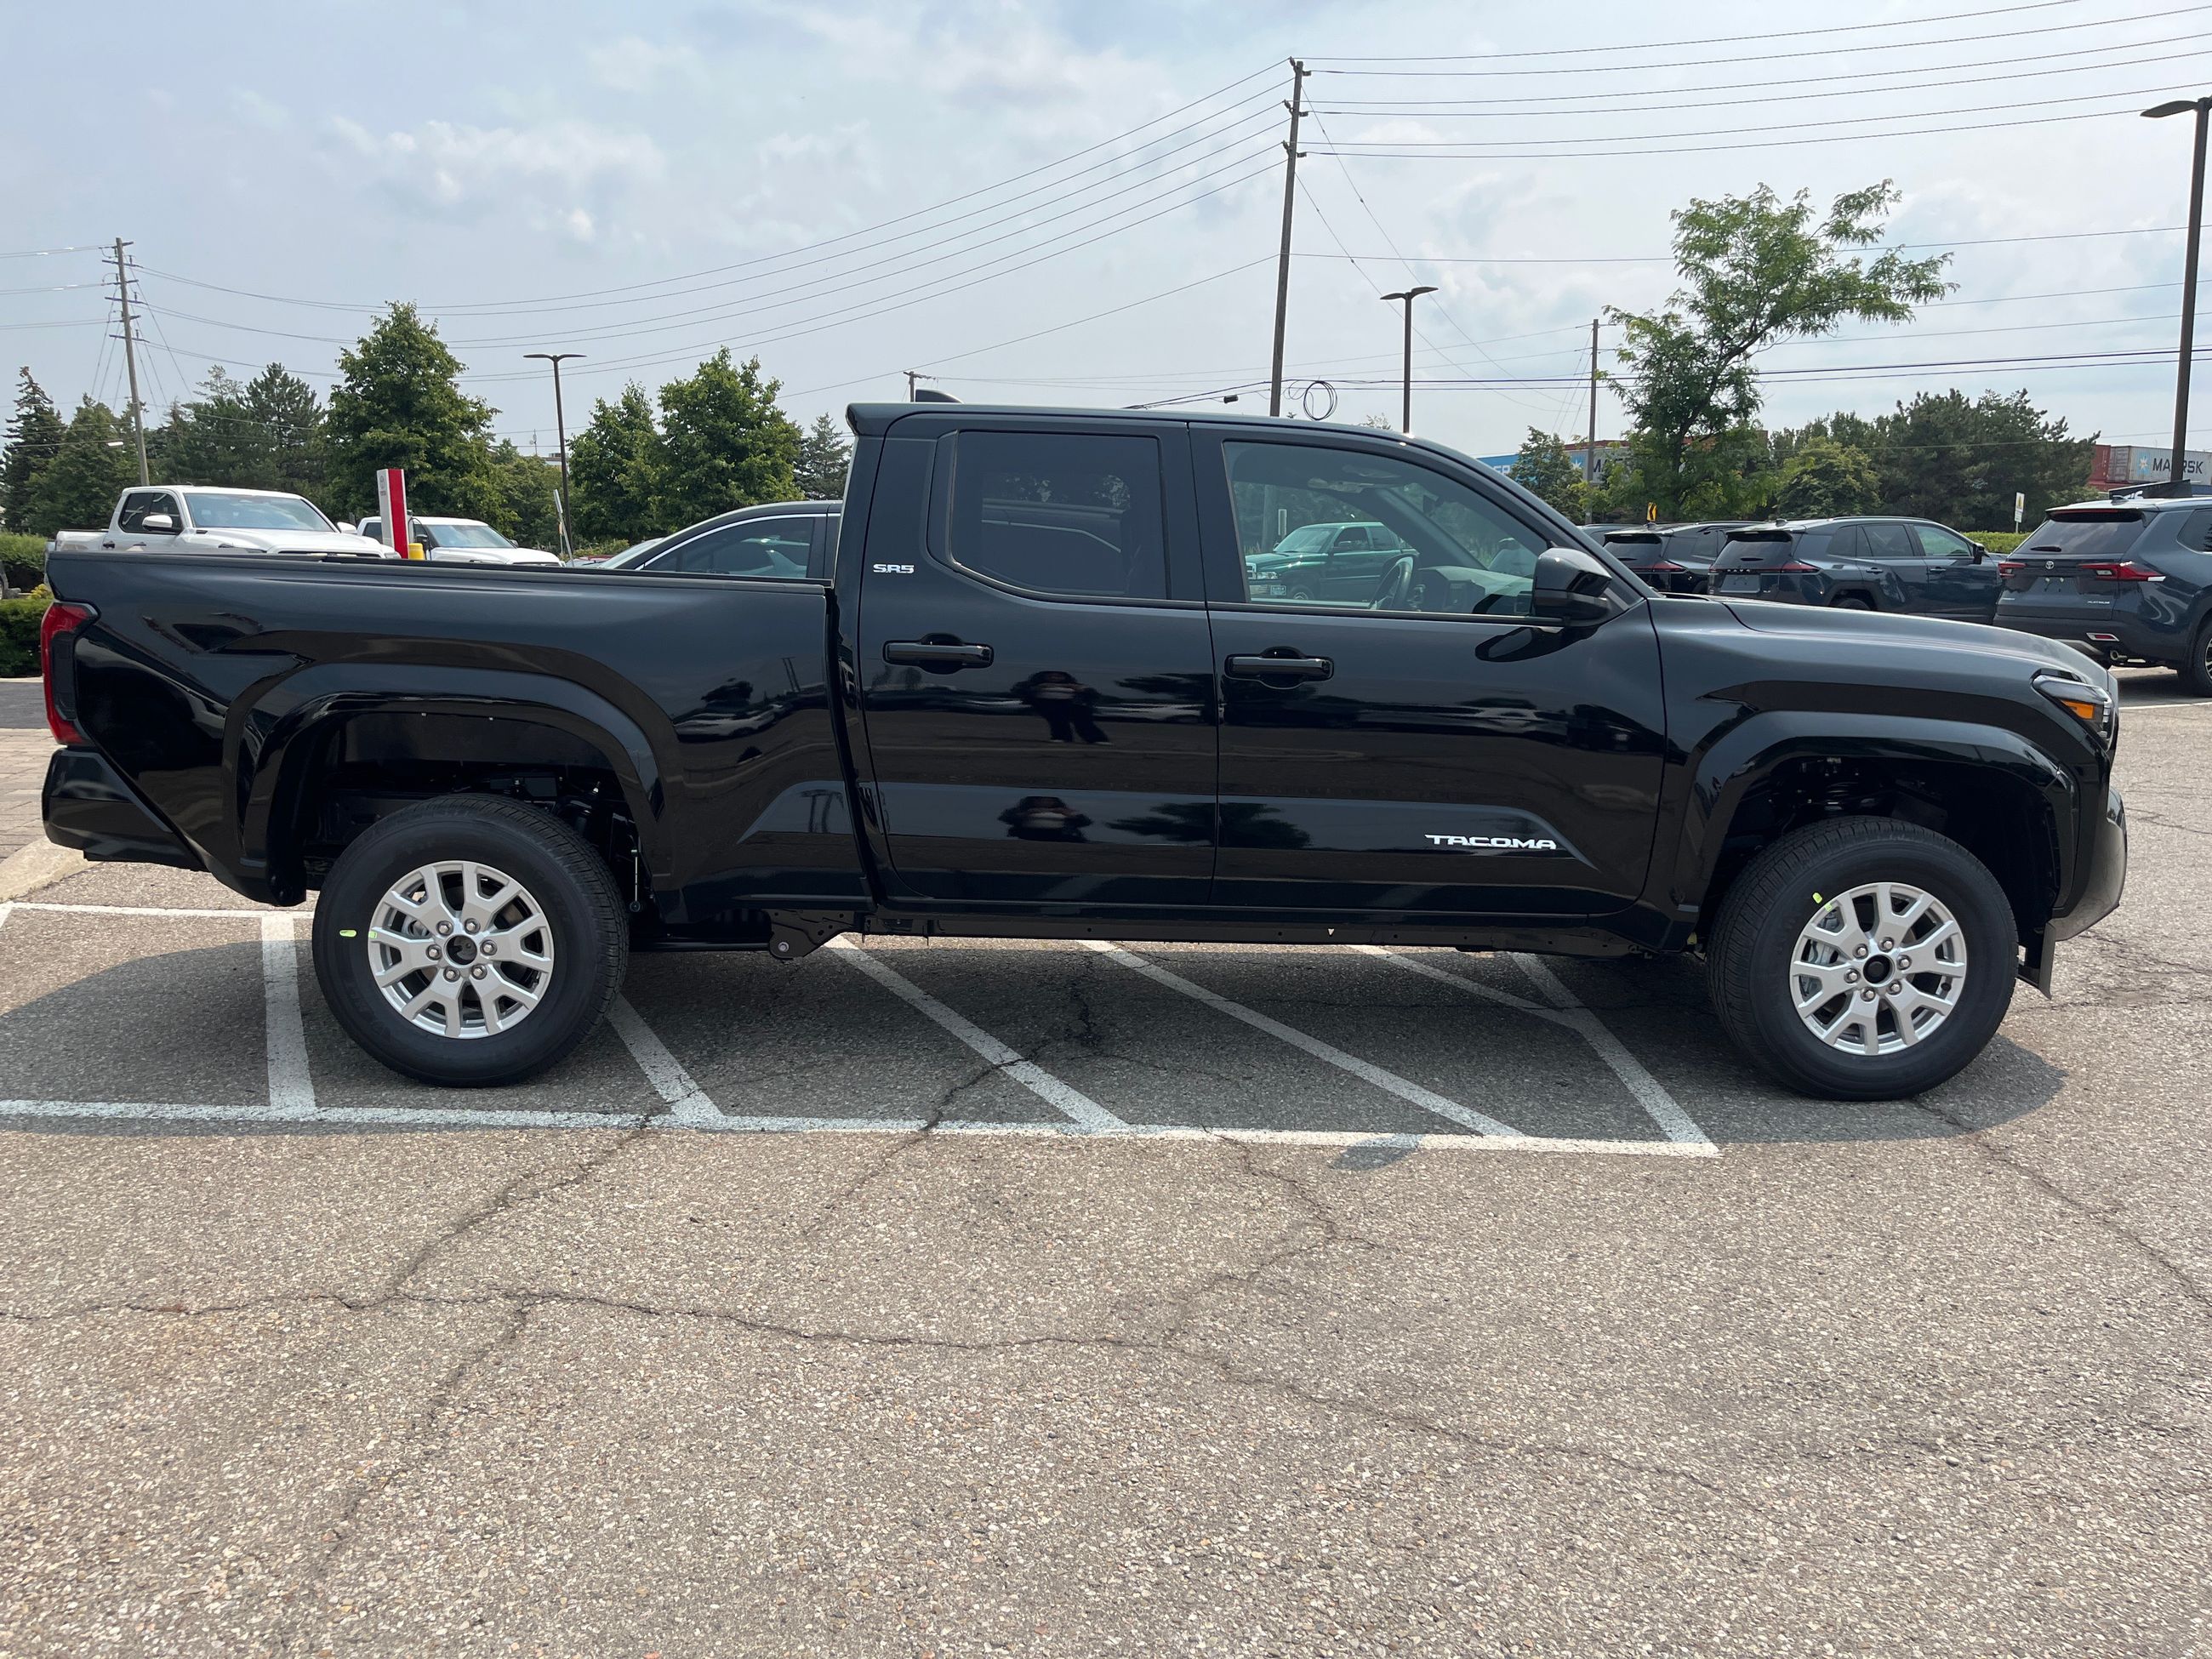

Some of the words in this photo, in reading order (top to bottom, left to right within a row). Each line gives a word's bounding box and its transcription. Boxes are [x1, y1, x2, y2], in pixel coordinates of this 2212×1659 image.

[2152, 458, 2203, 474] MARSK
[873, 563, 915, 574] SR5
[1424, 834, 1557, 850] TACOMA
